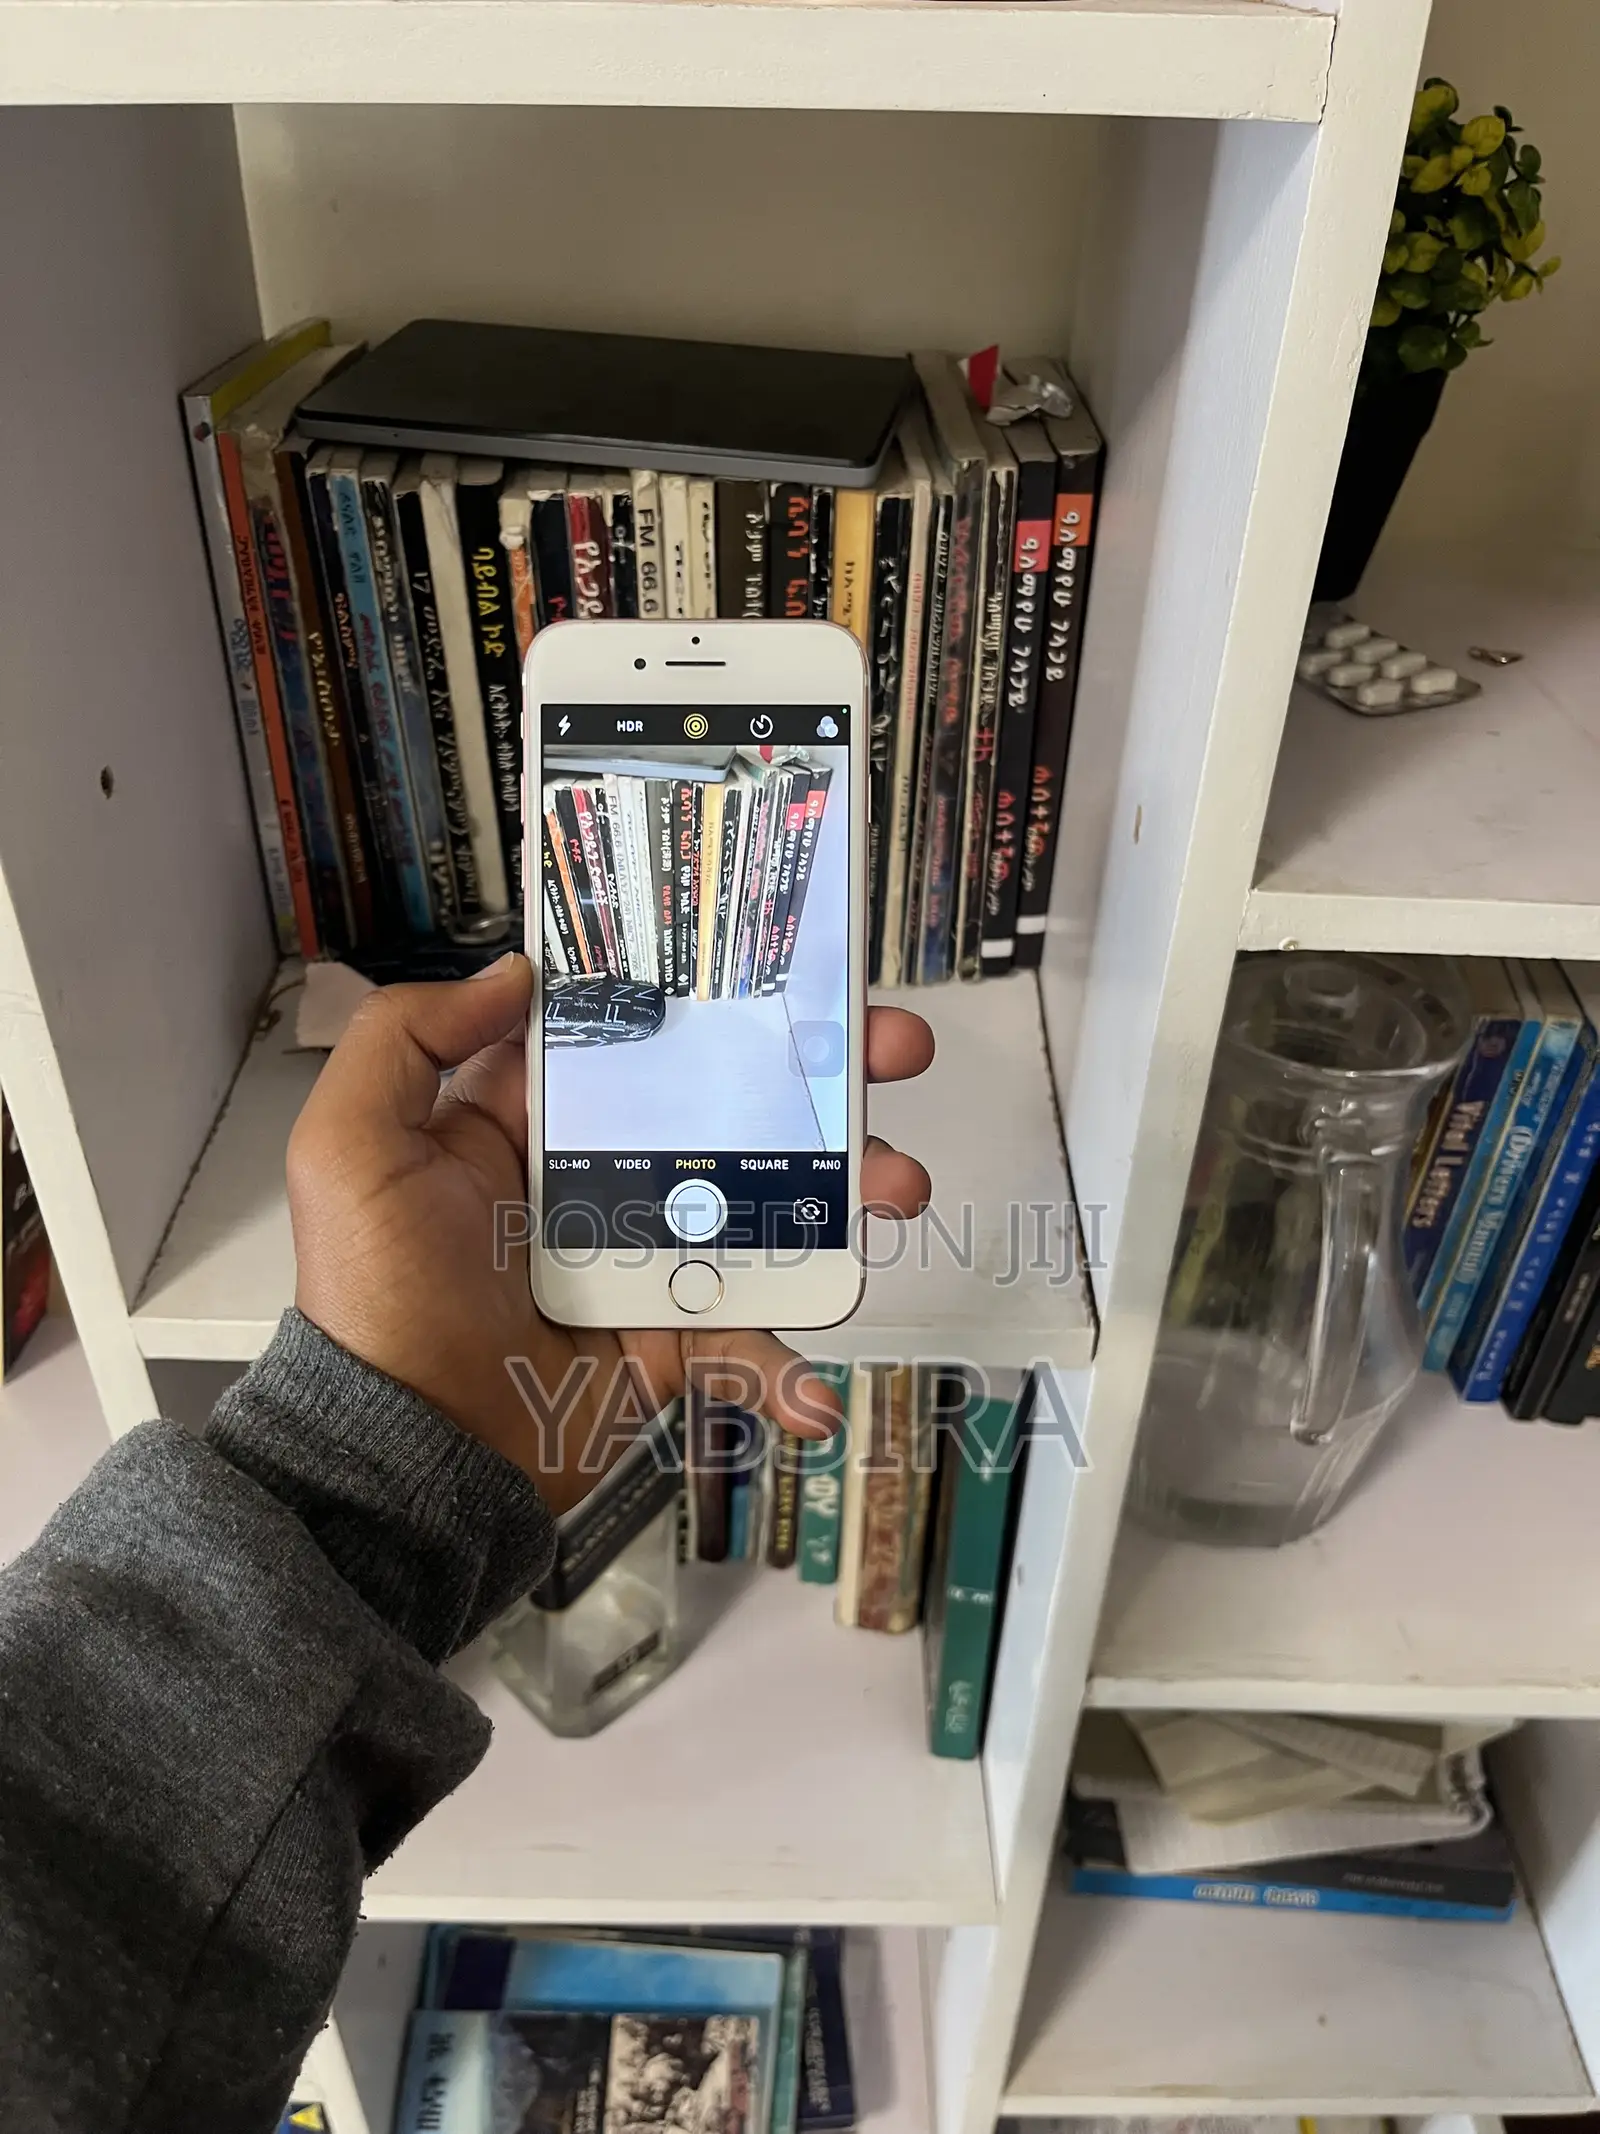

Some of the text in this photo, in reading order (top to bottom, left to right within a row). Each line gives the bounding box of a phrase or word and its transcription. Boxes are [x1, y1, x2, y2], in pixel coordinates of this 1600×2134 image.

[470, 546, 500, 616] ባይብል
[636, 508, 659, 614] FM 66.6
[615, 719, 644, 733] HDR
[548, 1157, 842, 1172] SLO-MO VIDEO PHOTO SQUARE PANO
